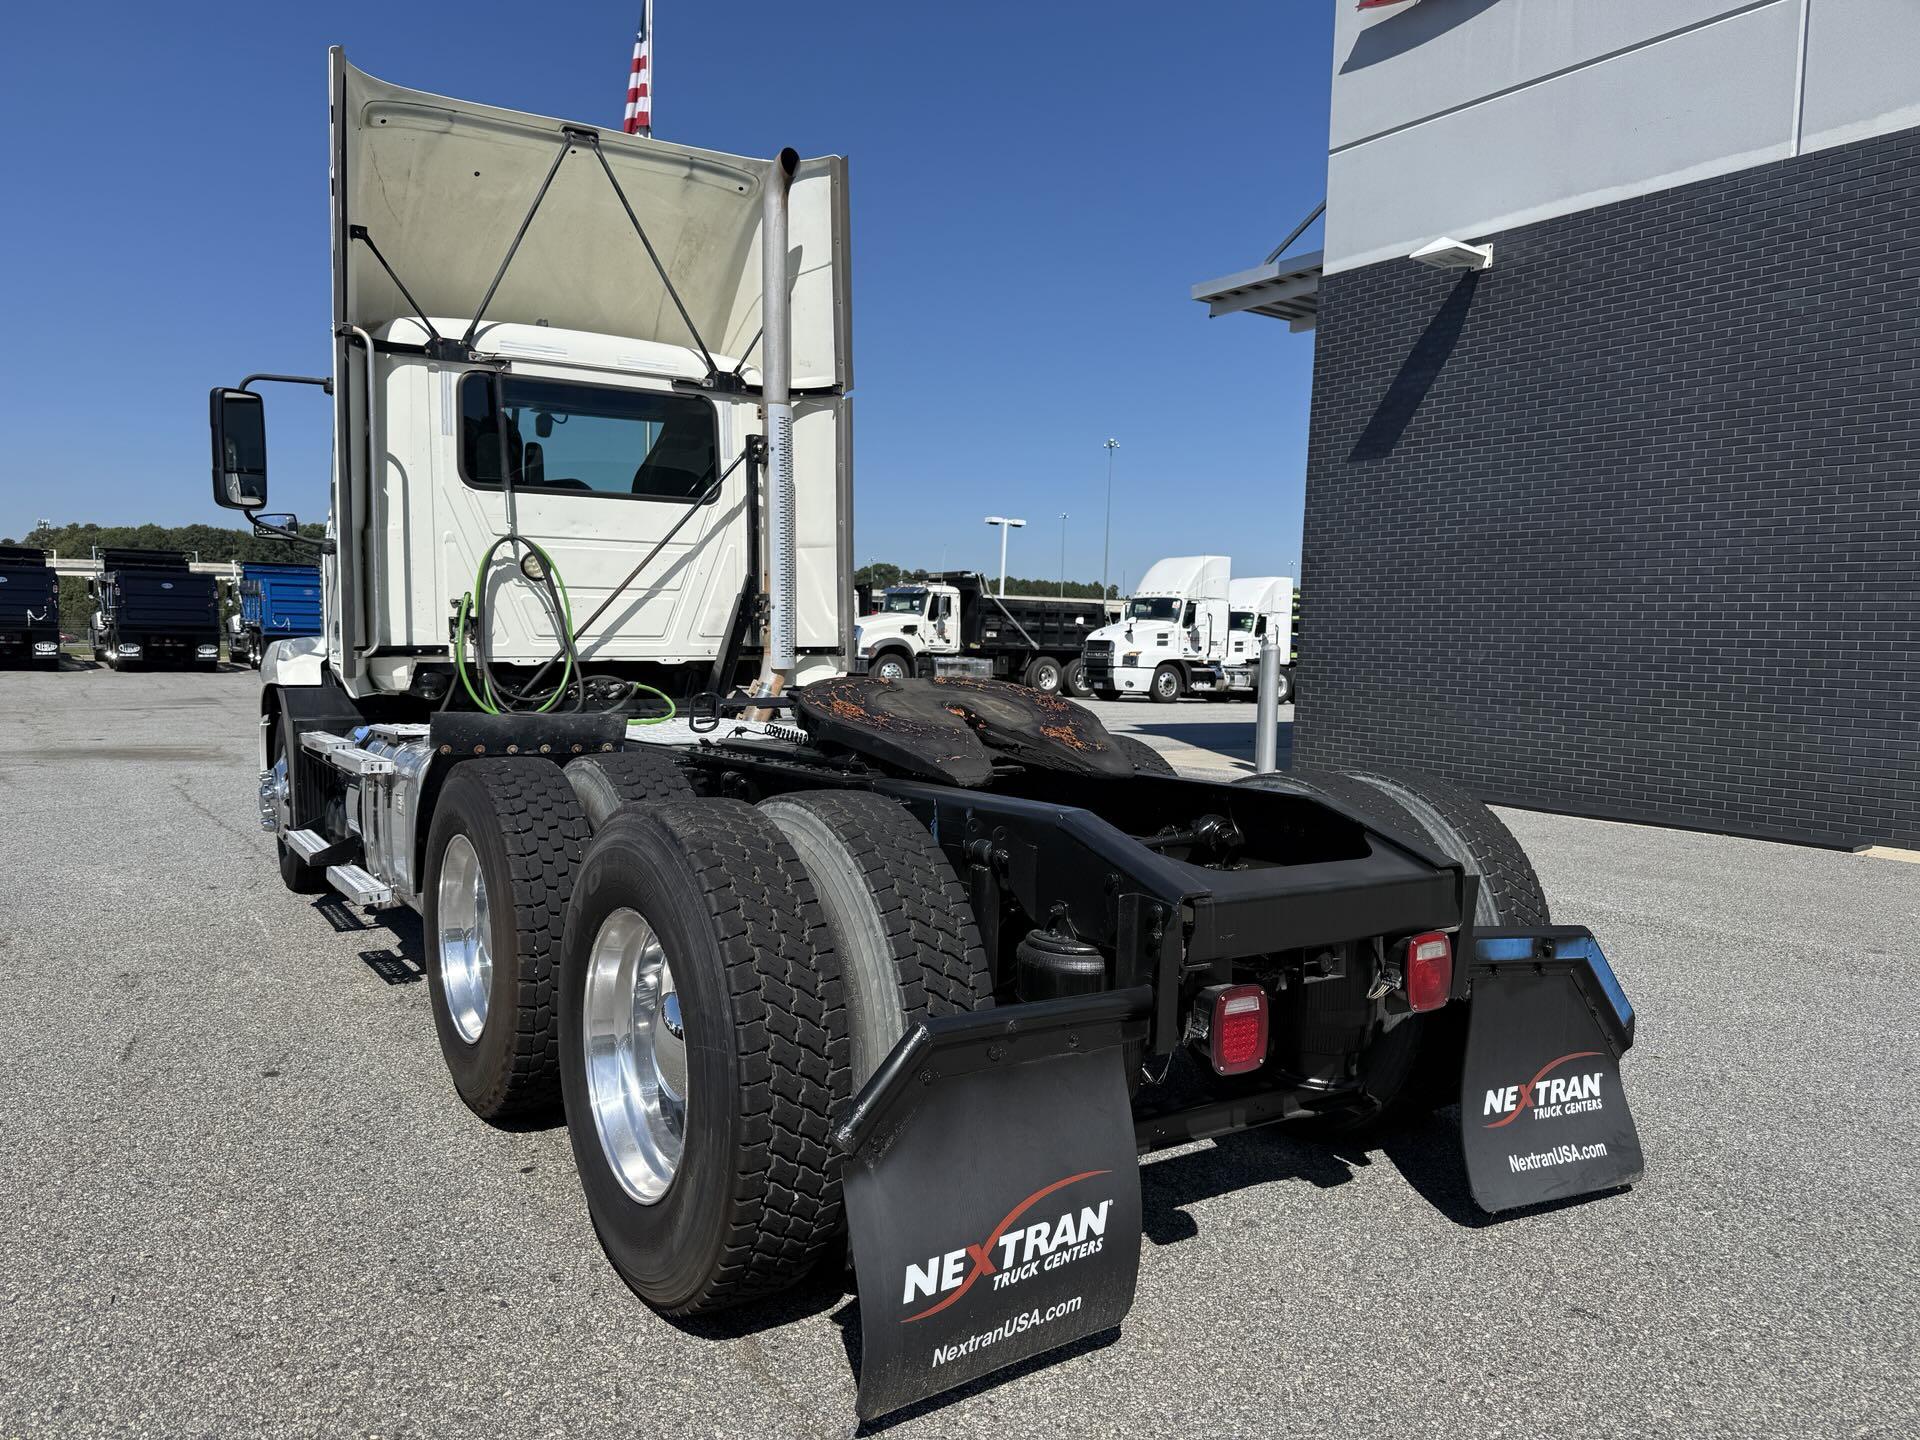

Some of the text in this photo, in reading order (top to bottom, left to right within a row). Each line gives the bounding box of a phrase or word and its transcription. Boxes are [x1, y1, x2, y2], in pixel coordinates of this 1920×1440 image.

[1483, 1073, 1601, 1116] NEXTRAN
[1533, 1099, 1603, 1120] TRUCK CENTERS
[1508, 1142, 1608, 1173] NextranUSA.com
[903, 1200, 1109, 1305] NEXTRAN
[993, 1237, 1104, 1291] TRUCK CENTERS
[932, 1296, 1082, 1368] NextranUSA.com
